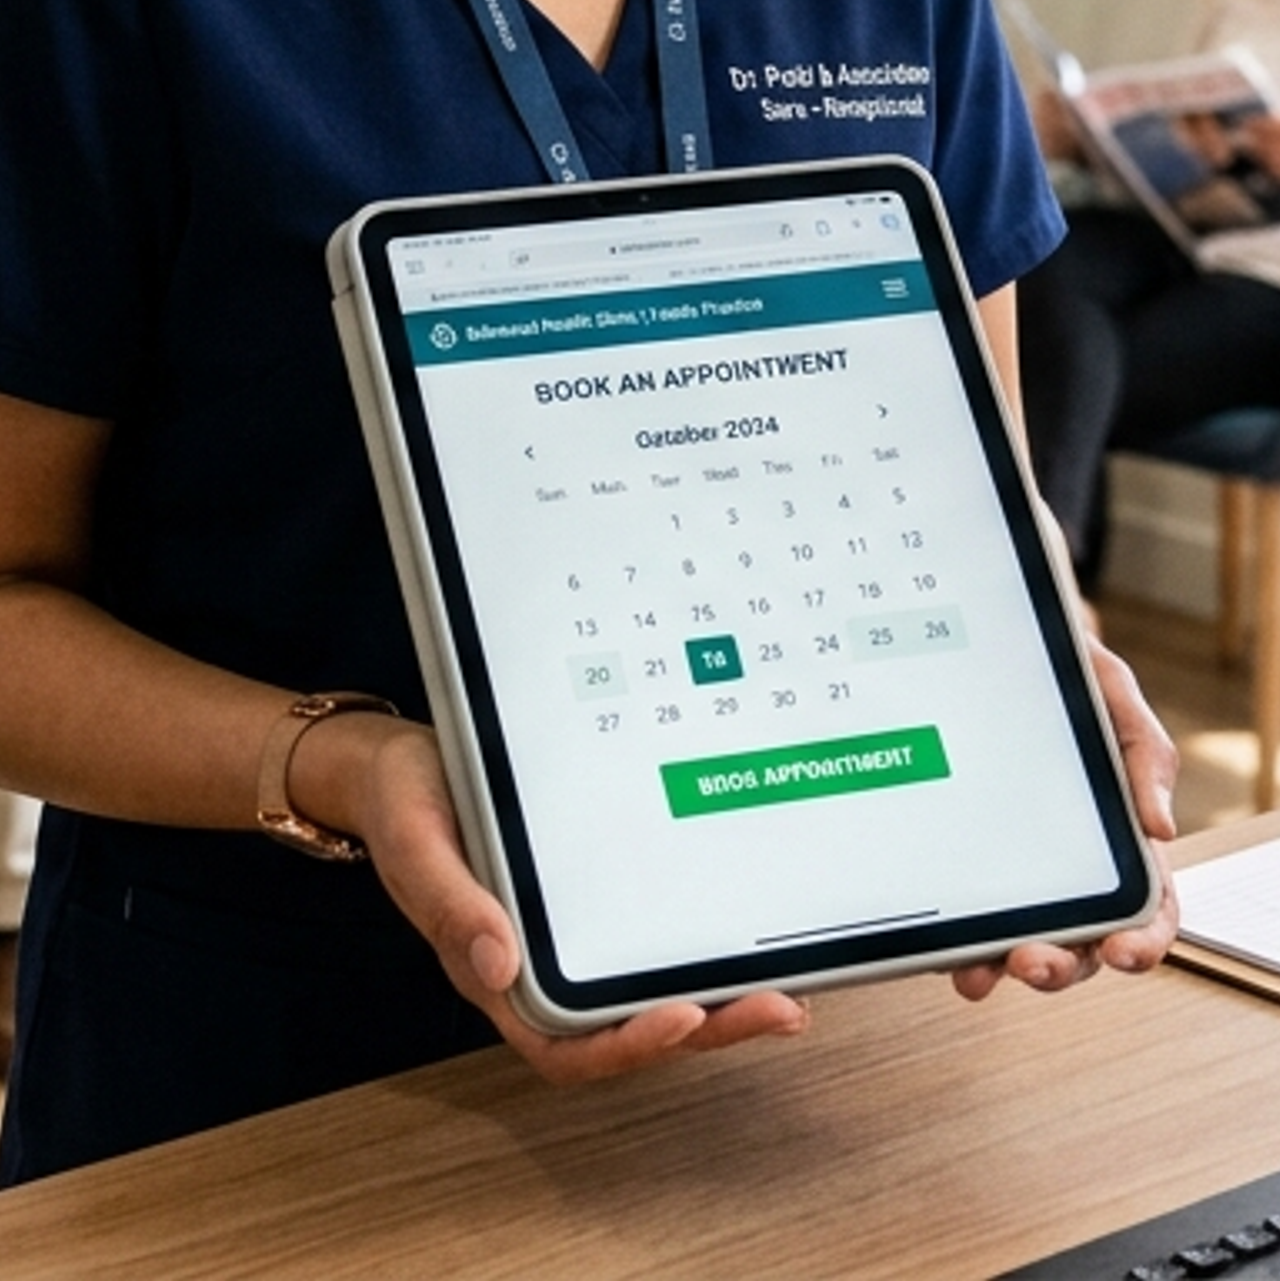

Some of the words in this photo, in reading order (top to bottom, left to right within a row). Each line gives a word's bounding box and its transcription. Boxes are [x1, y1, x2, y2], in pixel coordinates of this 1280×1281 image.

[534, 375, 612, 405] BOOK
[619, 370, 656, 395] AN
[671, 513, 681, 531] 1
[838, 494, 851, 509] 4
[567, 573, 581, 591] 6
[624, 566, 637, 583] 7
[682, 558, 696, 577] 8
[790, 543, 814, 562] 10
[847, 537, 867, 555] 11
[574, 617, 598, 637] 13
[633, 610, 657, 628] 14
[803, 588, 825, 608] 17
[585, 666, 611, 686] 20
[644, 657, 667, 677] 21
[815, 634, 840, 654] 24
[868, 627, 894, 646] 25
[596, 713, 620, 733] 27
[771, 689, 797, 709] 30
